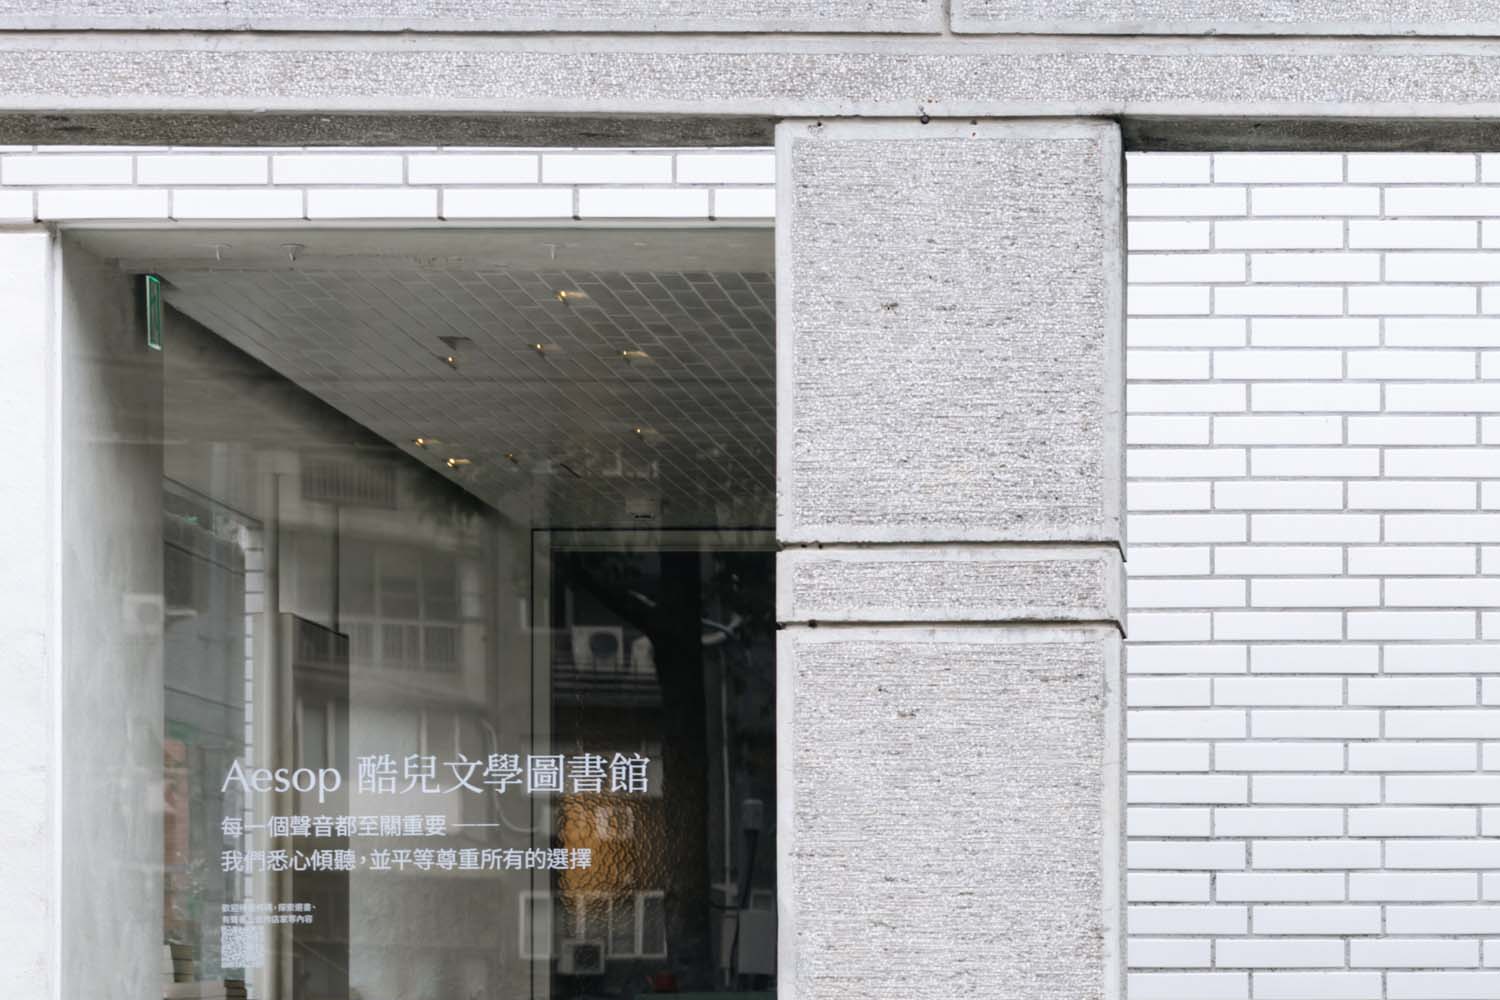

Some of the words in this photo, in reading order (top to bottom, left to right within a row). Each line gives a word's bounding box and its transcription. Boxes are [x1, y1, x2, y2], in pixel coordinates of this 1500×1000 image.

[221, 759, 342, 804] Aesop
[356, 752, 651, 795] 酷兒文學圖書館
